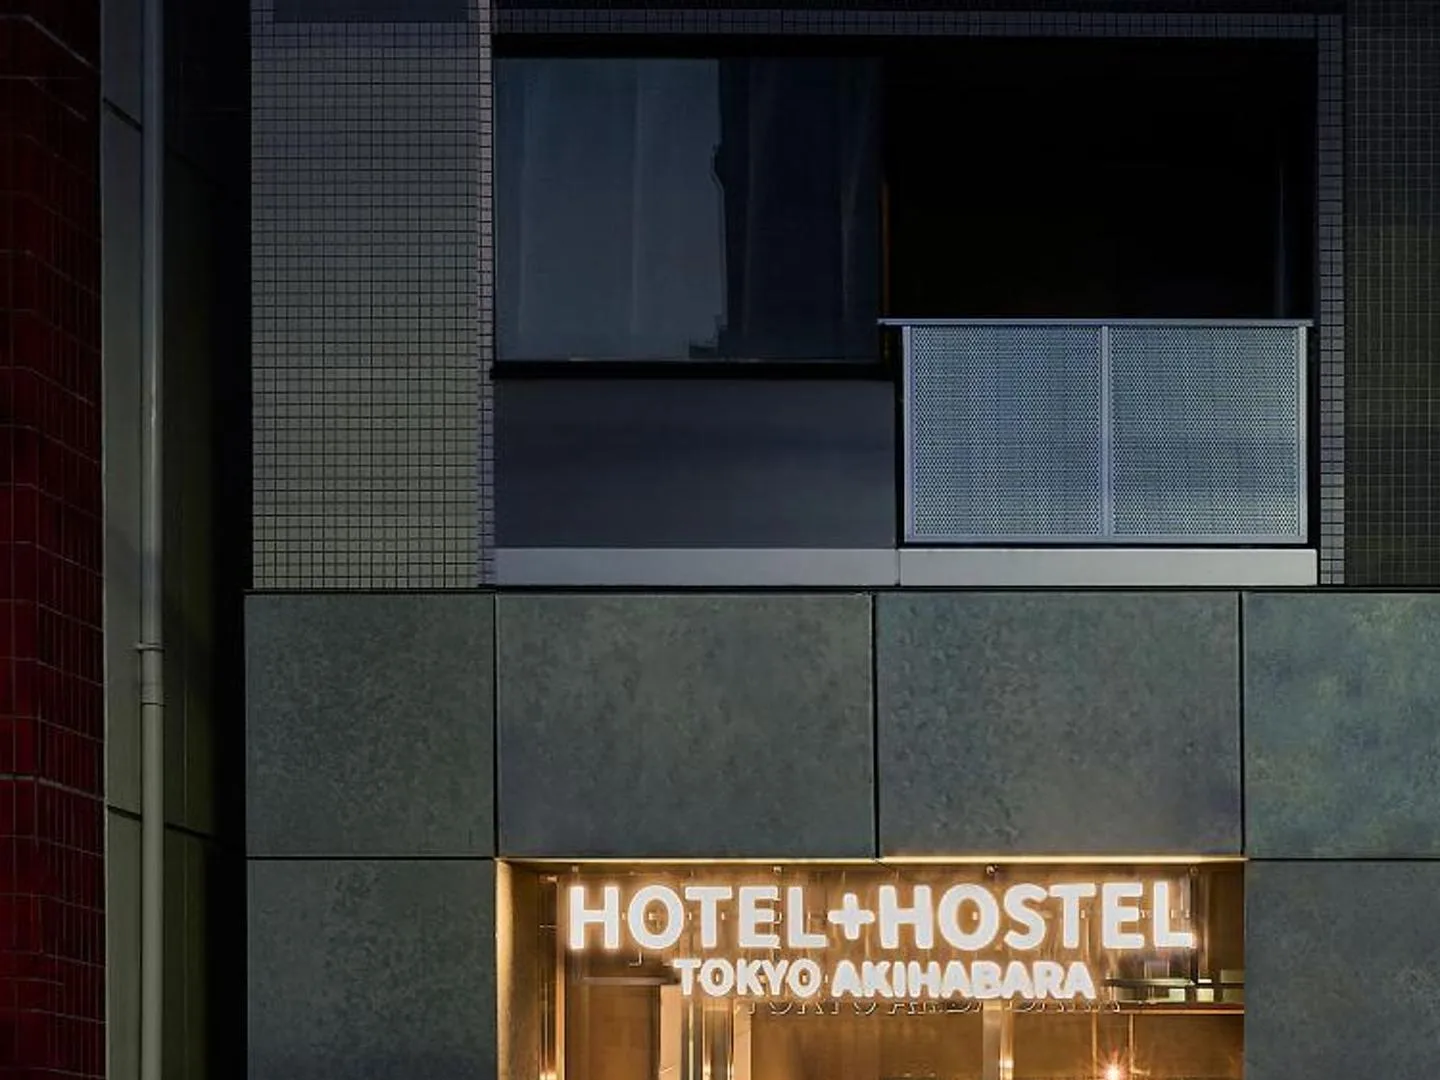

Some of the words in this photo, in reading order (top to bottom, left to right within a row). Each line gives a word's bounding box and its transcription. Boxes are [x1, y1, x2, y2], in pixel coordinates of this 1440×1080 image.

[569, 881, 1195, 950] HOTEL+HOSTEL
[673, 957, 822, 998] TOKYO
[830, 959, 1096, 999] AKIHABARA
